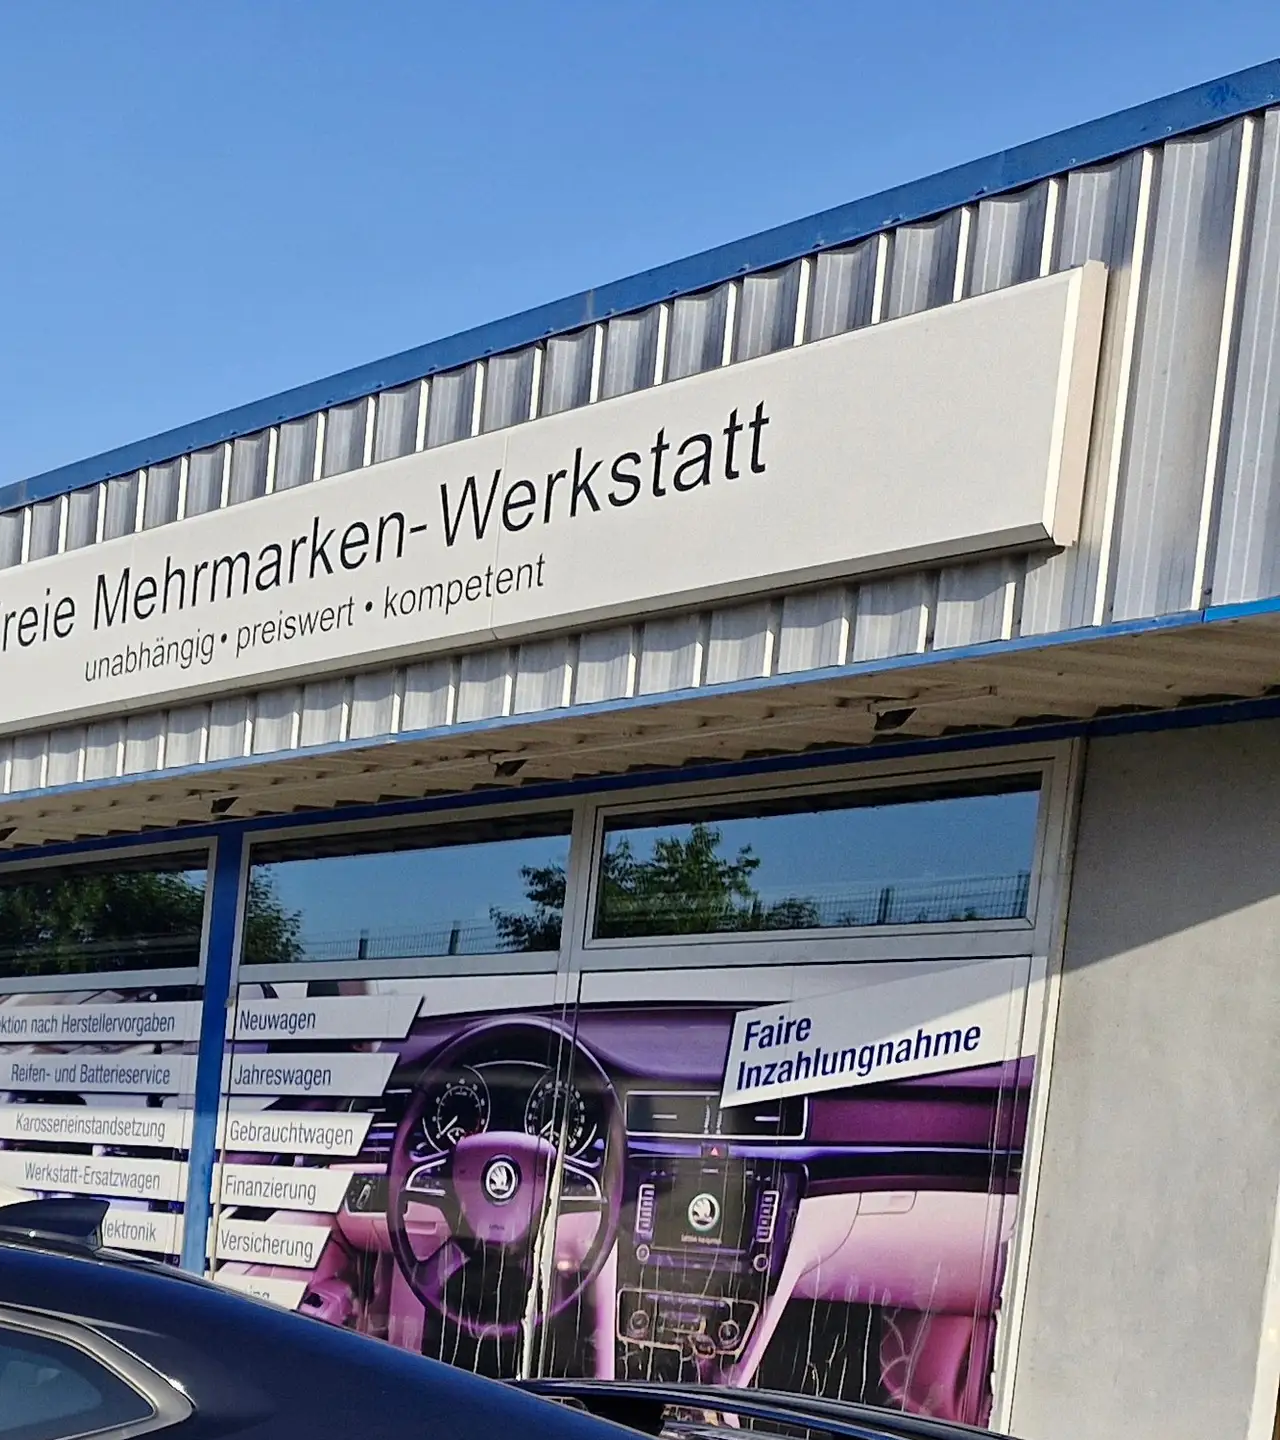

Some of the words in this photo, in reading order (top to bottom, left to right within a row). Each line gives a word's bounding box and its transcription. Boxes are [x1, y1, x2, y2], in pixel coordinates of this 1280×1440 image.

[92, 400, 770, 631] Mehrmarken-Werkstatt
[84, 628, 216, 682] unabhängig
[235, 597, 356, 659] preiswert
[383, 553, 546, 619] kompetent
[31, 1014, 57, 1034] nach
[61, 1012, 175, 1037] Herstellervorgaben
[239, 1009, 316, 1034] Neuwagen
[743, 1015, 812, 1052] Faire
[736, 1025, 981, 1091] Inzahlungnahme
[11, 1063, 51, 1083] Reifen-
[54, 1064, 76, 1083] und
[80, 1065, 170, 1085] Batterieservice
[234, 1064, 332, 1091] Jahreswagen
[15, 1112, 166, 1143] Karosserieinstandsetzung
[230, 1119, 354, 1150] Gebrauchtwagen
[24, 1161, 160, 1193] Werkstatt-Ersatzwagen
[225, 1174, 317, 1205] Finanzierung
[103, 1218, 157, 1242] lektronik
[221, 1229, 314, 1263] Versicherung
